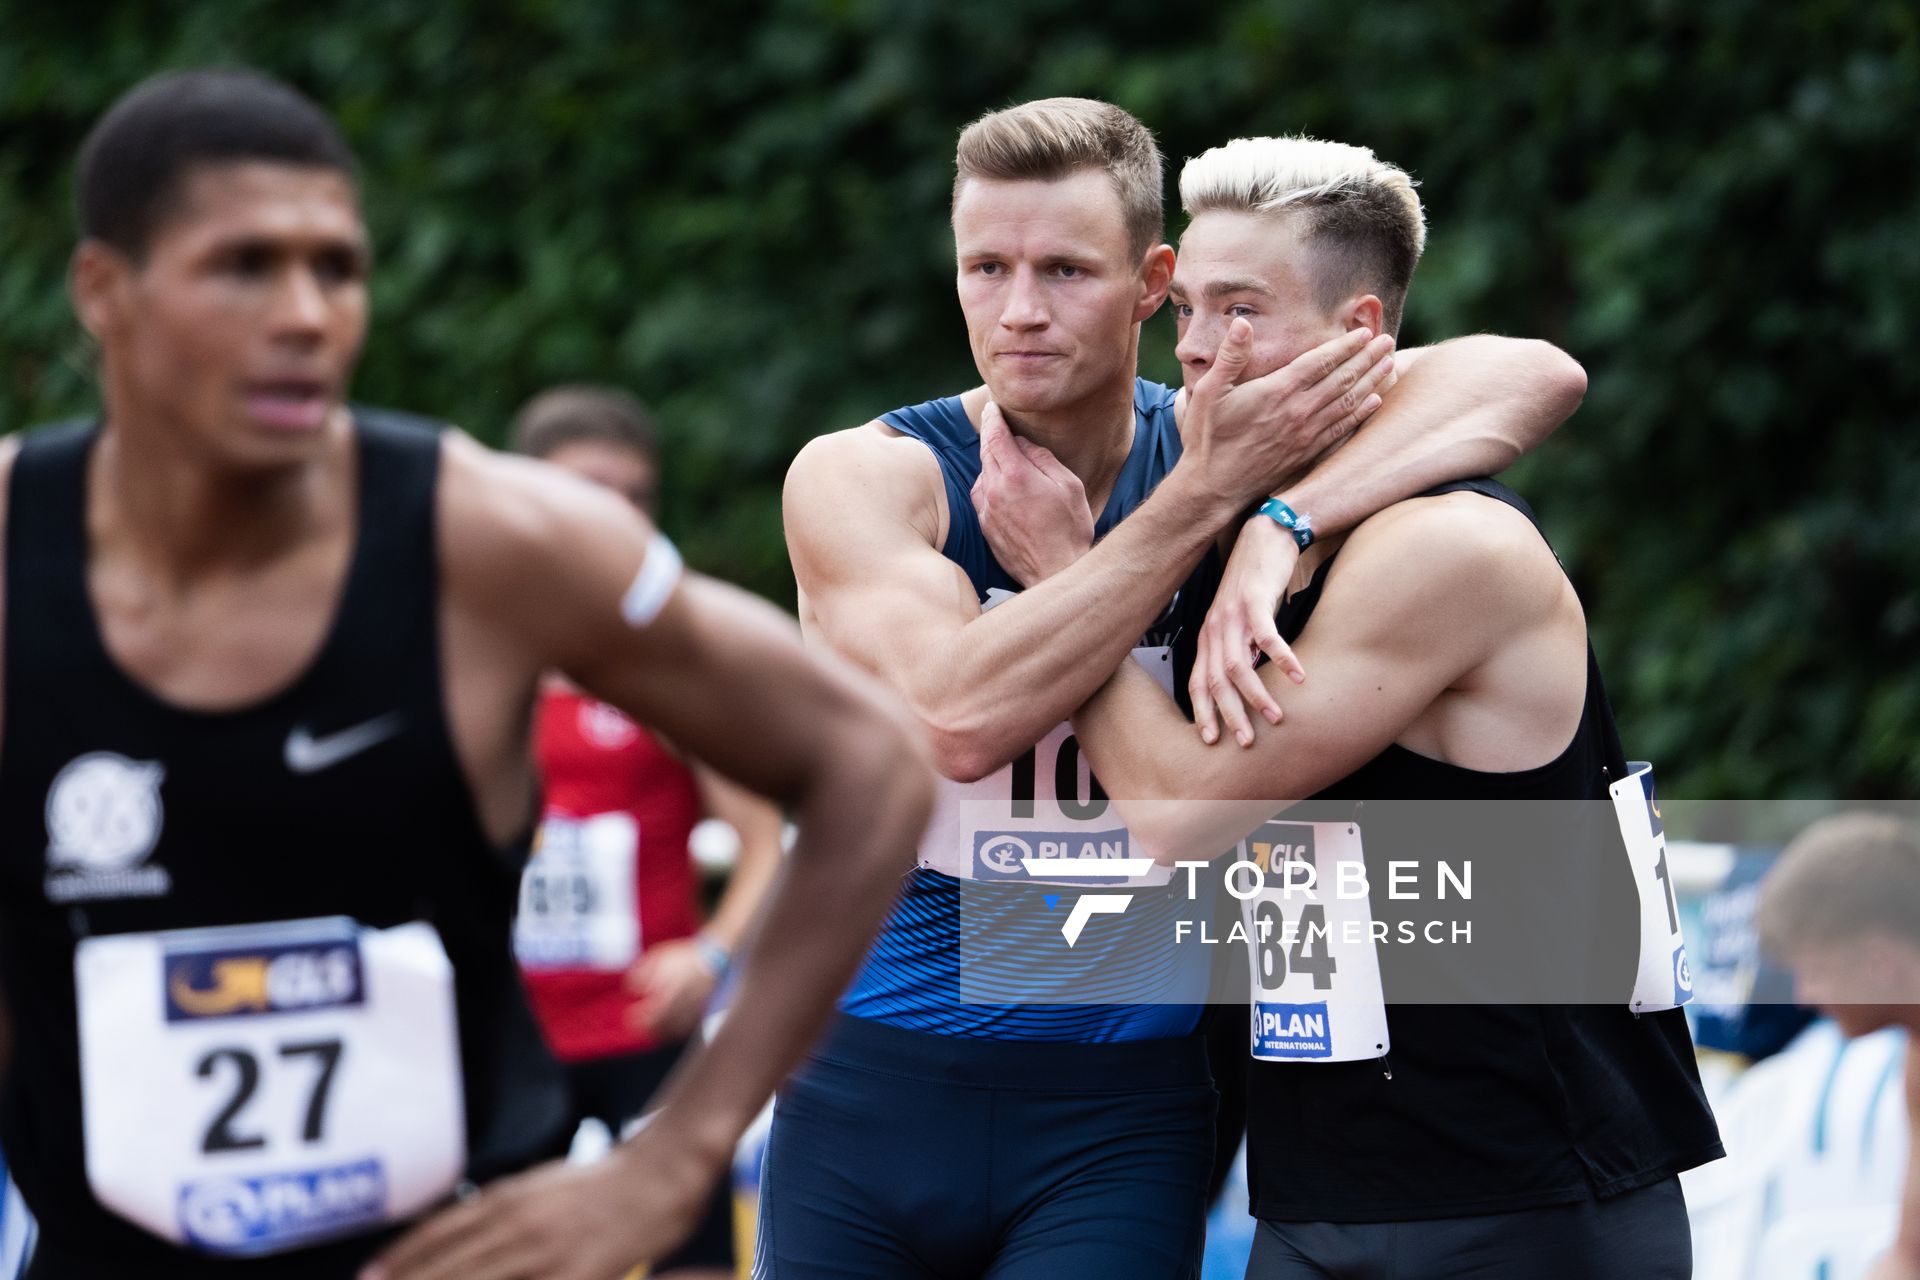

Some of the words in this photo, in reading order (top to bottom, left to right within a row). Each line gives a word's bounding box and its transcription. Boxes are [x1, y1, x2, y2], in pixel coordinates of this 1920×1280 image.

[1251, 900, 1336, 990] 84
[1264, 1013, 1324, 1038] PLAN
[1264, 1040, 1326, 1051] INTERNATIONAL
[197, 1040, 343, 1153] 27
